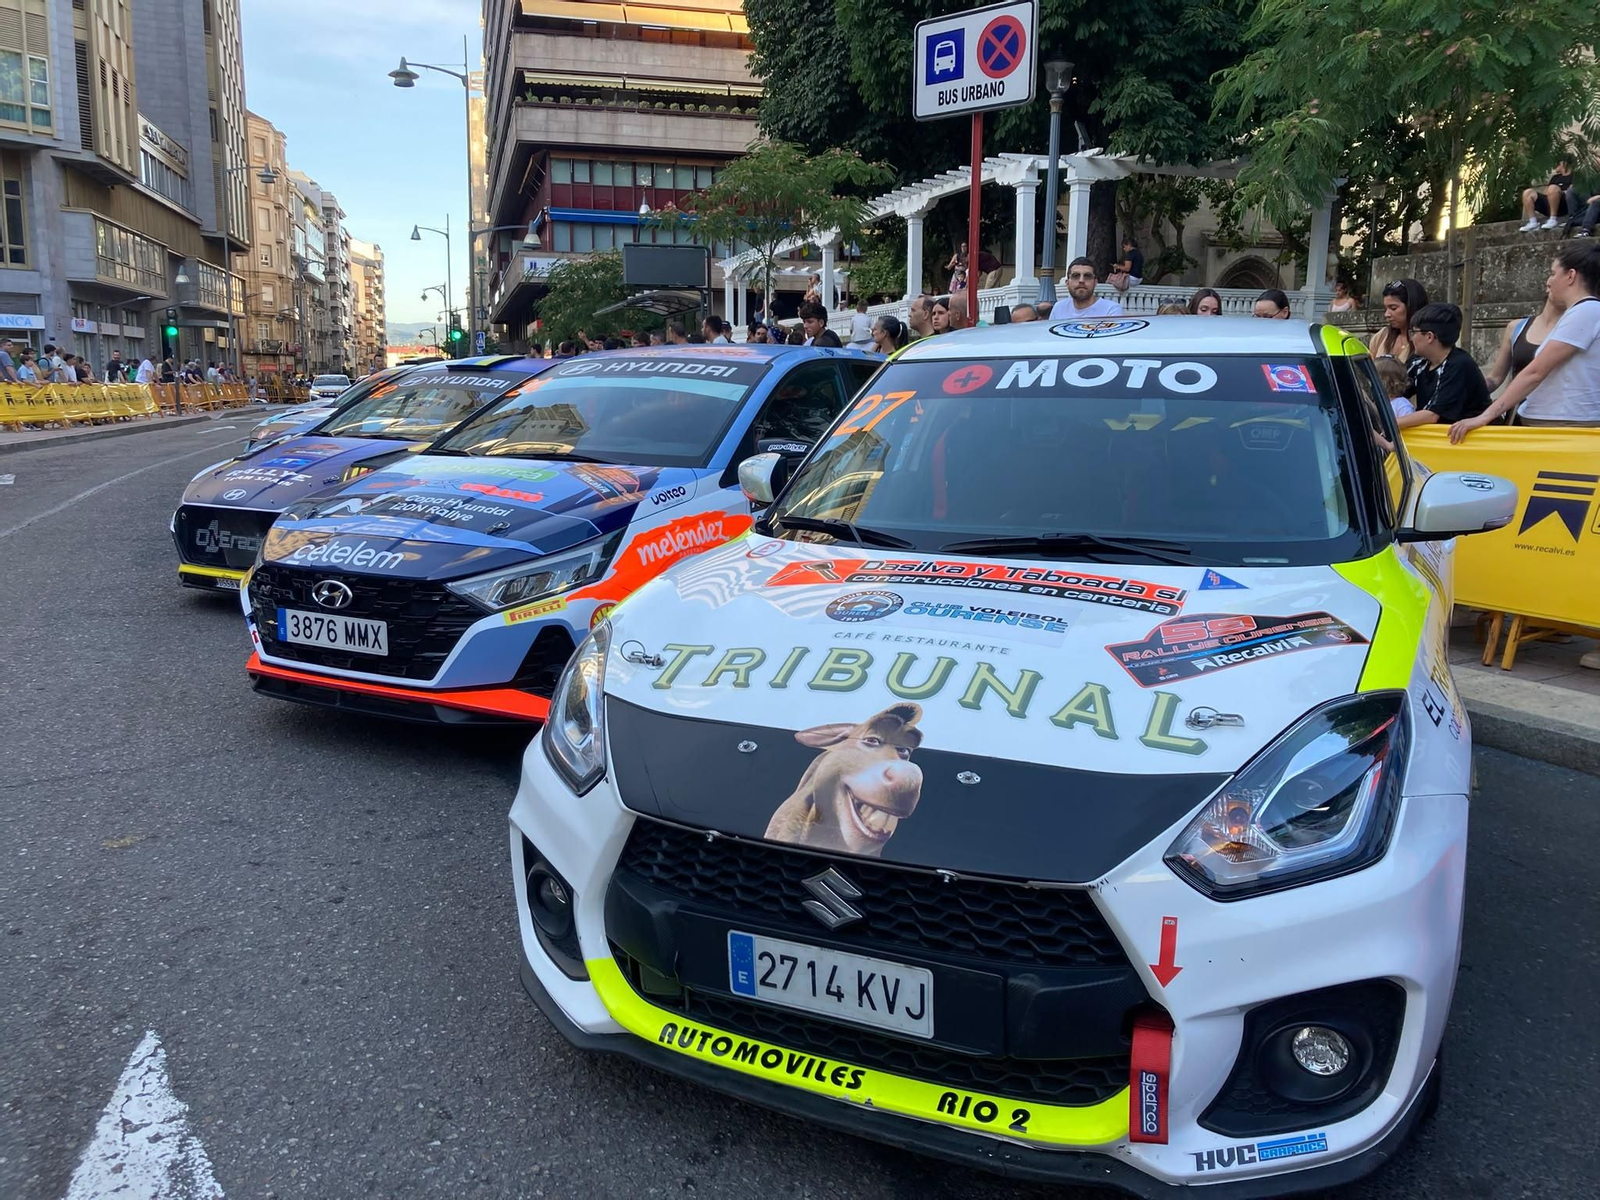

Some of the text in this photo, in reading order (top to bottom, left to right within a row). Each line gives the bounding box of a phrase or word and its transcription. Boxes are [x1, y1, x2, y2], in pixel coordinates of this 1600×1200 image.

[937, 80, 1005, 107] BUS URBANO
[426, 375, 511, 389] HYUNDAI
[604, 362, 738, 378] HYUNDAI
[995, 358, 1218, 394] MOTO
[832, 390, 918, 437] 27
[225, 468, 313, 482] RALLYE
[405, 494, 514, 517] Copa Hyundai
[426, 505, 474, 522] Rallye
[291, 541, 404, 570] cetelem
[637, 520, 730, 566] meléndez
[1514, 542, 1576, 557] www.recalvi.es
[857, 559, 967, 578] Dasilva
[1003, 566, 1153, 596] Taboada
[851, 573, 1173, 615] construcciones en canteria
[509, 600, 563, 622] PIRELLI
[903, 606, 1069, 634] OURENSE
[910, 601, 1069, 625] CLUB VOLEIBOL
[290, 614, 383, 650] 3876 MMX
[833, 629, 1011, 655] CAFÉ RESTAURANTE
[1123, 639, 1219, 662] RALLYE
[1222, 616, 1335, 646] OURENSE
[1160, 615, 1257, 645] 59
[1213, 639, 1290, 666] Recalvi
[651, 643, 1209, 756] TRIBUNAL
[738, 970, 749, 985] E
[757, 950, 928, 1021] 2714 KVJ
[659, 1021, 1032, 1134] AUTOMOVILES RIO 2
[1141, 1073, 1158, 1133] sparco
[1189, 1142, 1327, 1172] HVC GRAPHICS
